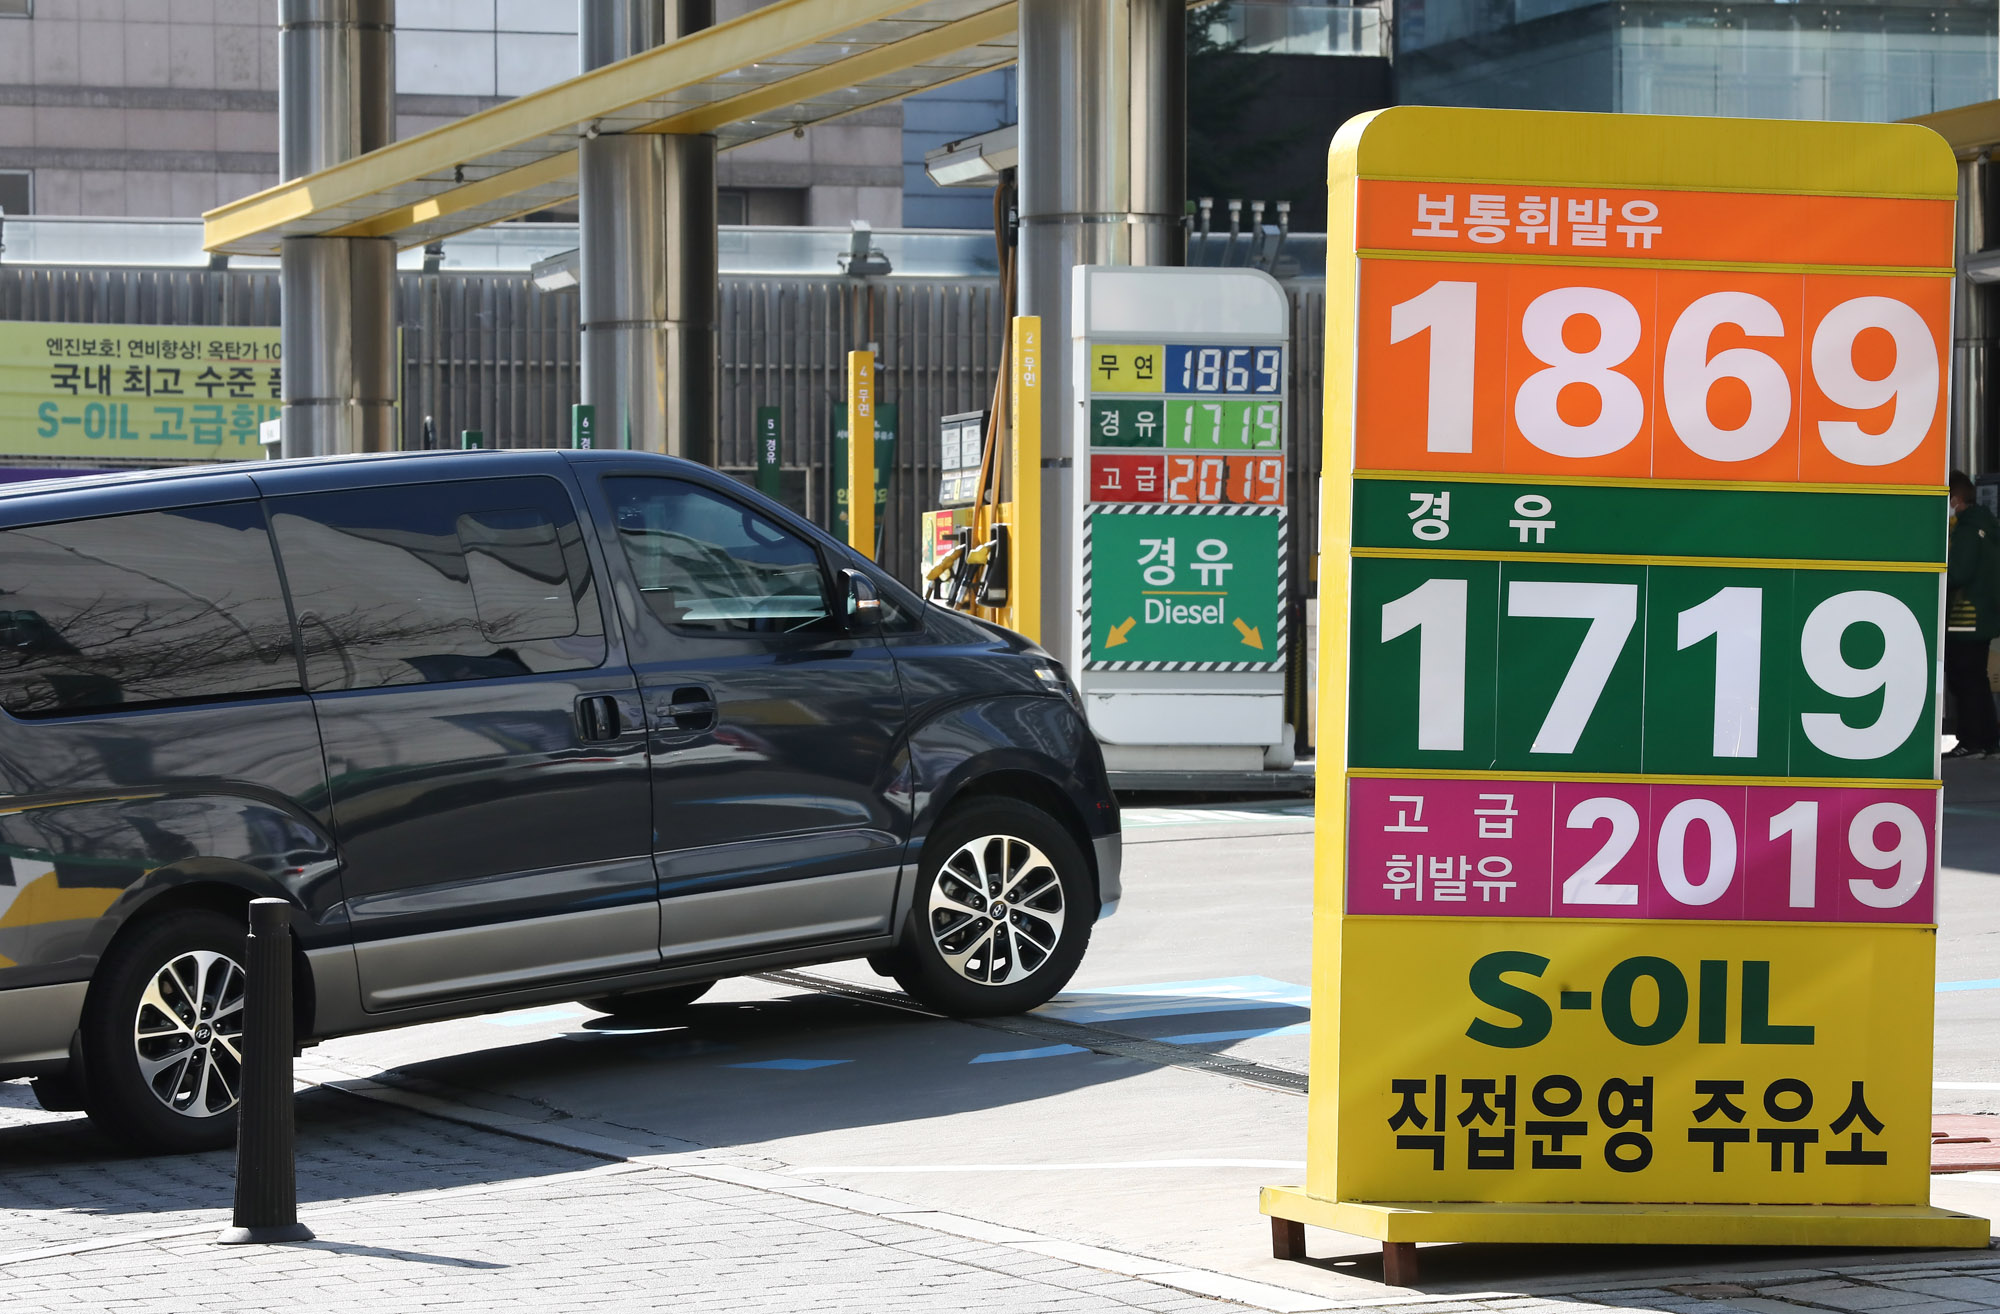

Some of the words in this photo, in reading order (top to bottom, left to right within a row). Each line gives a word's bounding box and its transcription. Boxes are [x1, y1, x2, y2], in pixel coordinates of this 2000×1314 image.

[1411, 193, 1663, 249] 보통휘발유
[46, 338, 121, 358] 엔진보호!
[128, 339, 201, 360] 연비향상!
[208, 341, 258, 360] 옥탄가
[1182, 349, 1280, 392] 1869
[1390, 280, 1940, 467] 1869
[51, 364, 111, 397] 국내
[123, 365, 184, 397] 최고
[195, 366, 256, 398] 수준
[37, 401, 139, 440] S-OIL
[1183, 404, 1280, 447] 1719
[1169, 458, 1282, 501] 2019
[1137, 537, 1233, 587] 경유
[1145, 598, 1224, 625] Diesel
[1381, 578, 1928, 761] 1719
[1562, 796, 1928, 909] 2019
[1382, 854, 1518, 903] 휘발유
[1465, 951, 1815, 1049] S-OIL
[1388, 1074, 1654, 1173] 직접운영
[1687, 1077, 1888, 1174] 주유소
